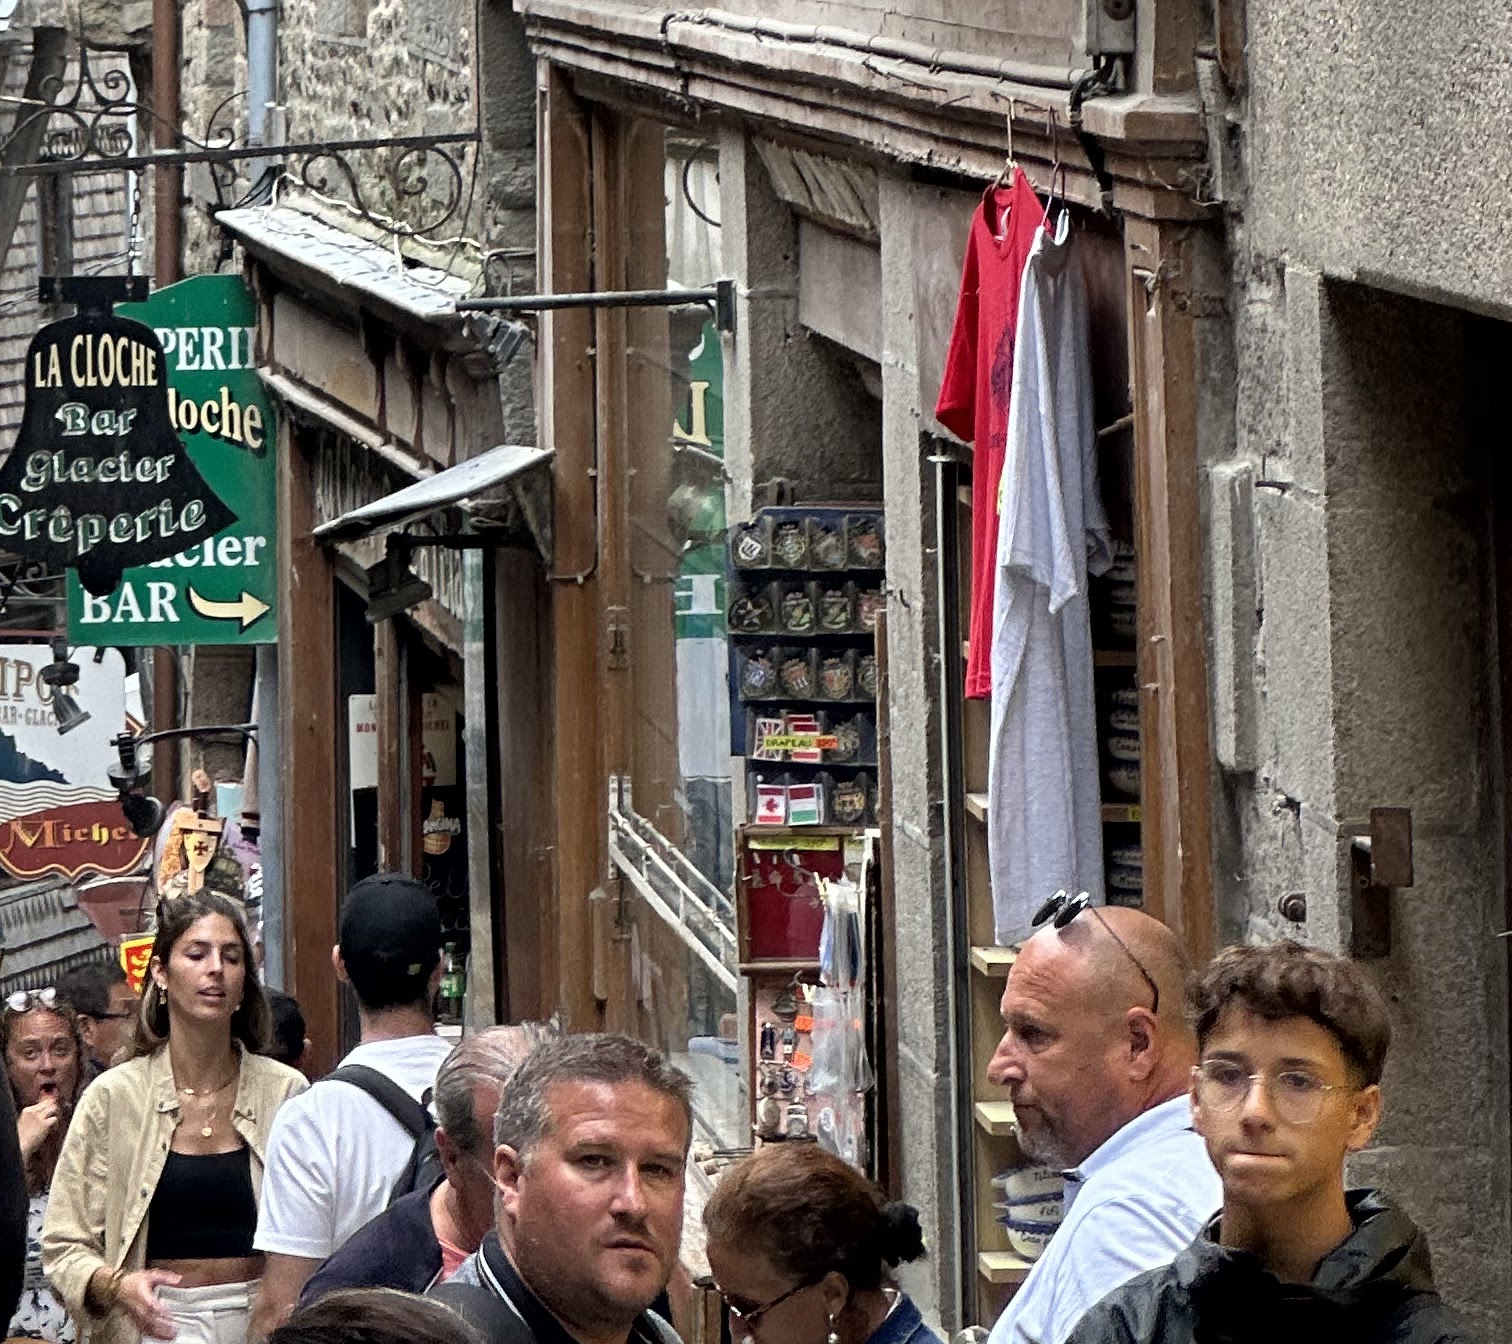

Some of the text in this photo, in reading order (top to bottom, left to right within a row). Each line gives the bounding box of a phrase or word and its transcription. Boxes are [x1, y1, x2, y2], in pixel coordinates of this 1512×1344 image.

[34, 333, 158, 388] LA CLOCHE
[54, 401, 138, 437] Bar
[167, 386, 263, 449] loche
[149, 535, 267, 568] cier
[79, 581, 181, 624] BAR
[3, 819, 139, 854] Miche
